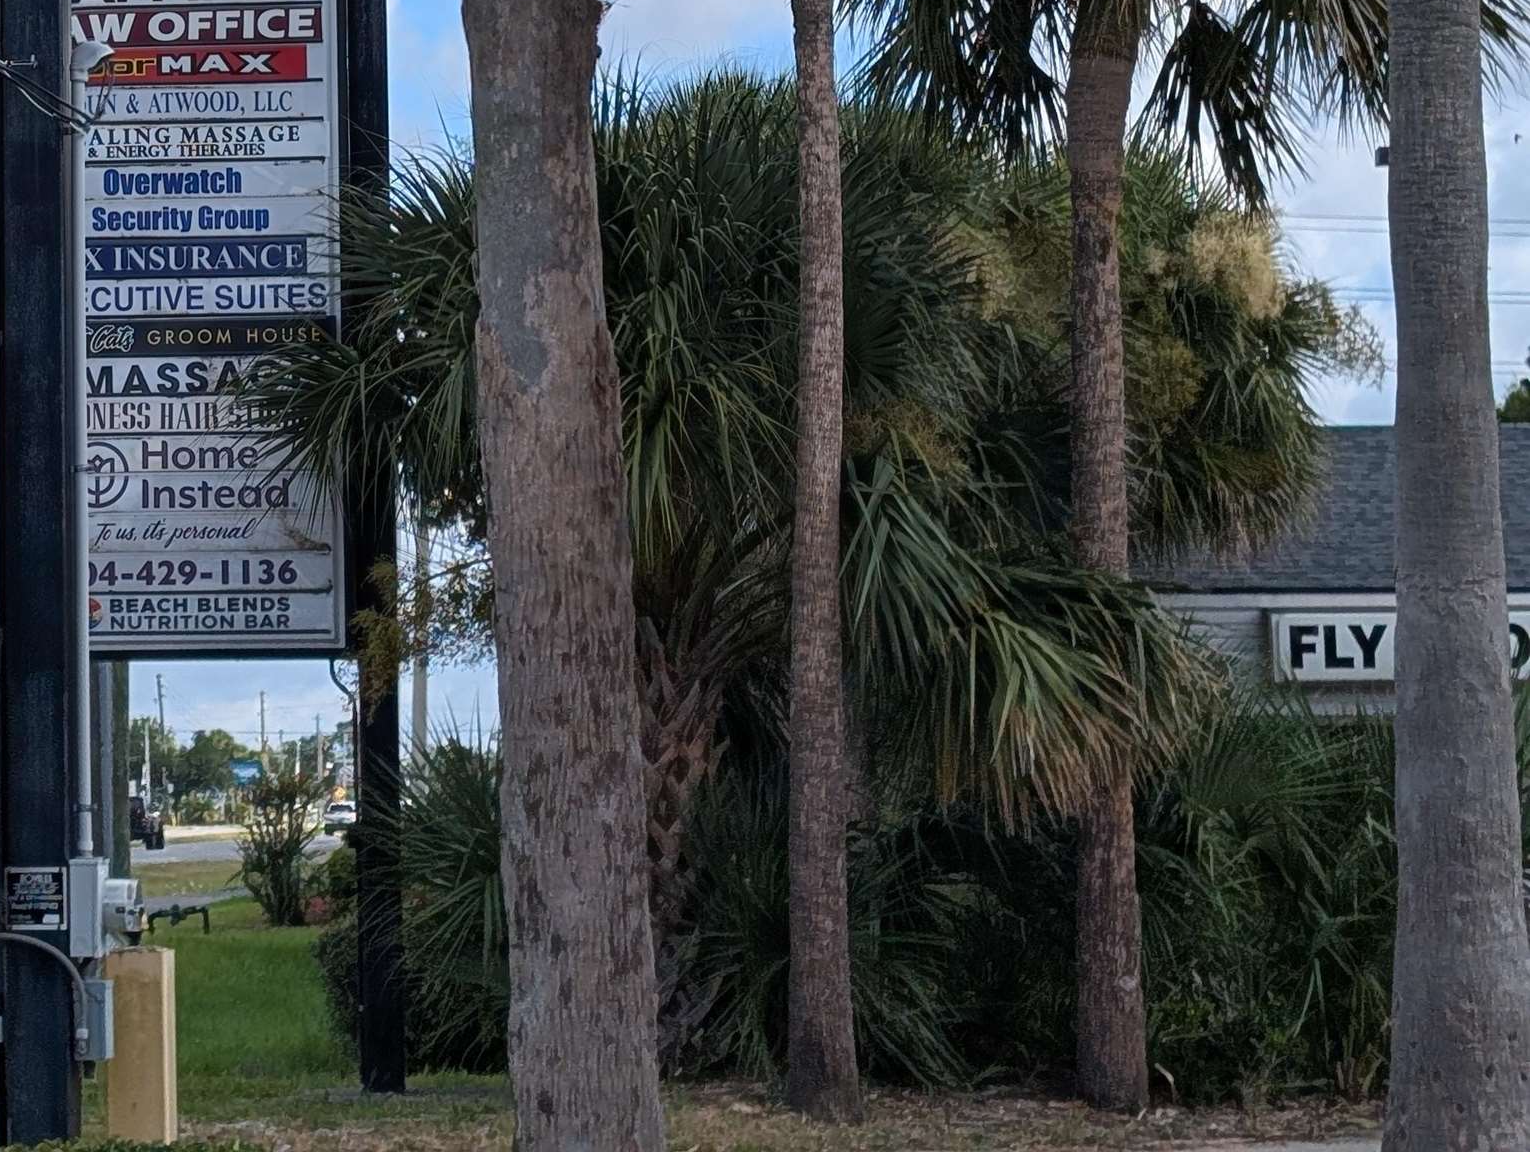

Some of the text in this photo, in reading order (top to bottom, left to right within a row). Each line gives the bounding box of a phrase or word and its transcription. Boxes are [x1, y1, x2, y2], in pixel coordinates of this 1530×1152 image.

[148, 8, 315, 42] OFFICE
[125, 93, 140, 114] &
[148, 91, 246, 115] ATWOOD,
[254, 90, 293, 112] LLC
[89, 125, 301, 146] ALING MASSAGE
[88, 143, 266, 158] & ENERGY THERAPIES
[103, 167, 242, 196] Overwatch
[92, 205, 270, 232] Security Group
[114, 244, 304, 271] INSURANCE
[86, 282, 328, 312] CUTIVE SUITES
[146, 328, 232, 345] GROOM
[246, 327, 321, 343] HOUSE
[87, 402, 151, 431] NESS
[141, 439, 258, 470] Home
[94, 522, 116, 546] To
[116, 525, 137, 541] us,
[164, 517, 257, 548] personal
[109, 597, 291, 613] BEACH BLENDS
[110, 614, 290, 630] NUTRITION BAR
[1288, 624, 1388, 669] FLY
